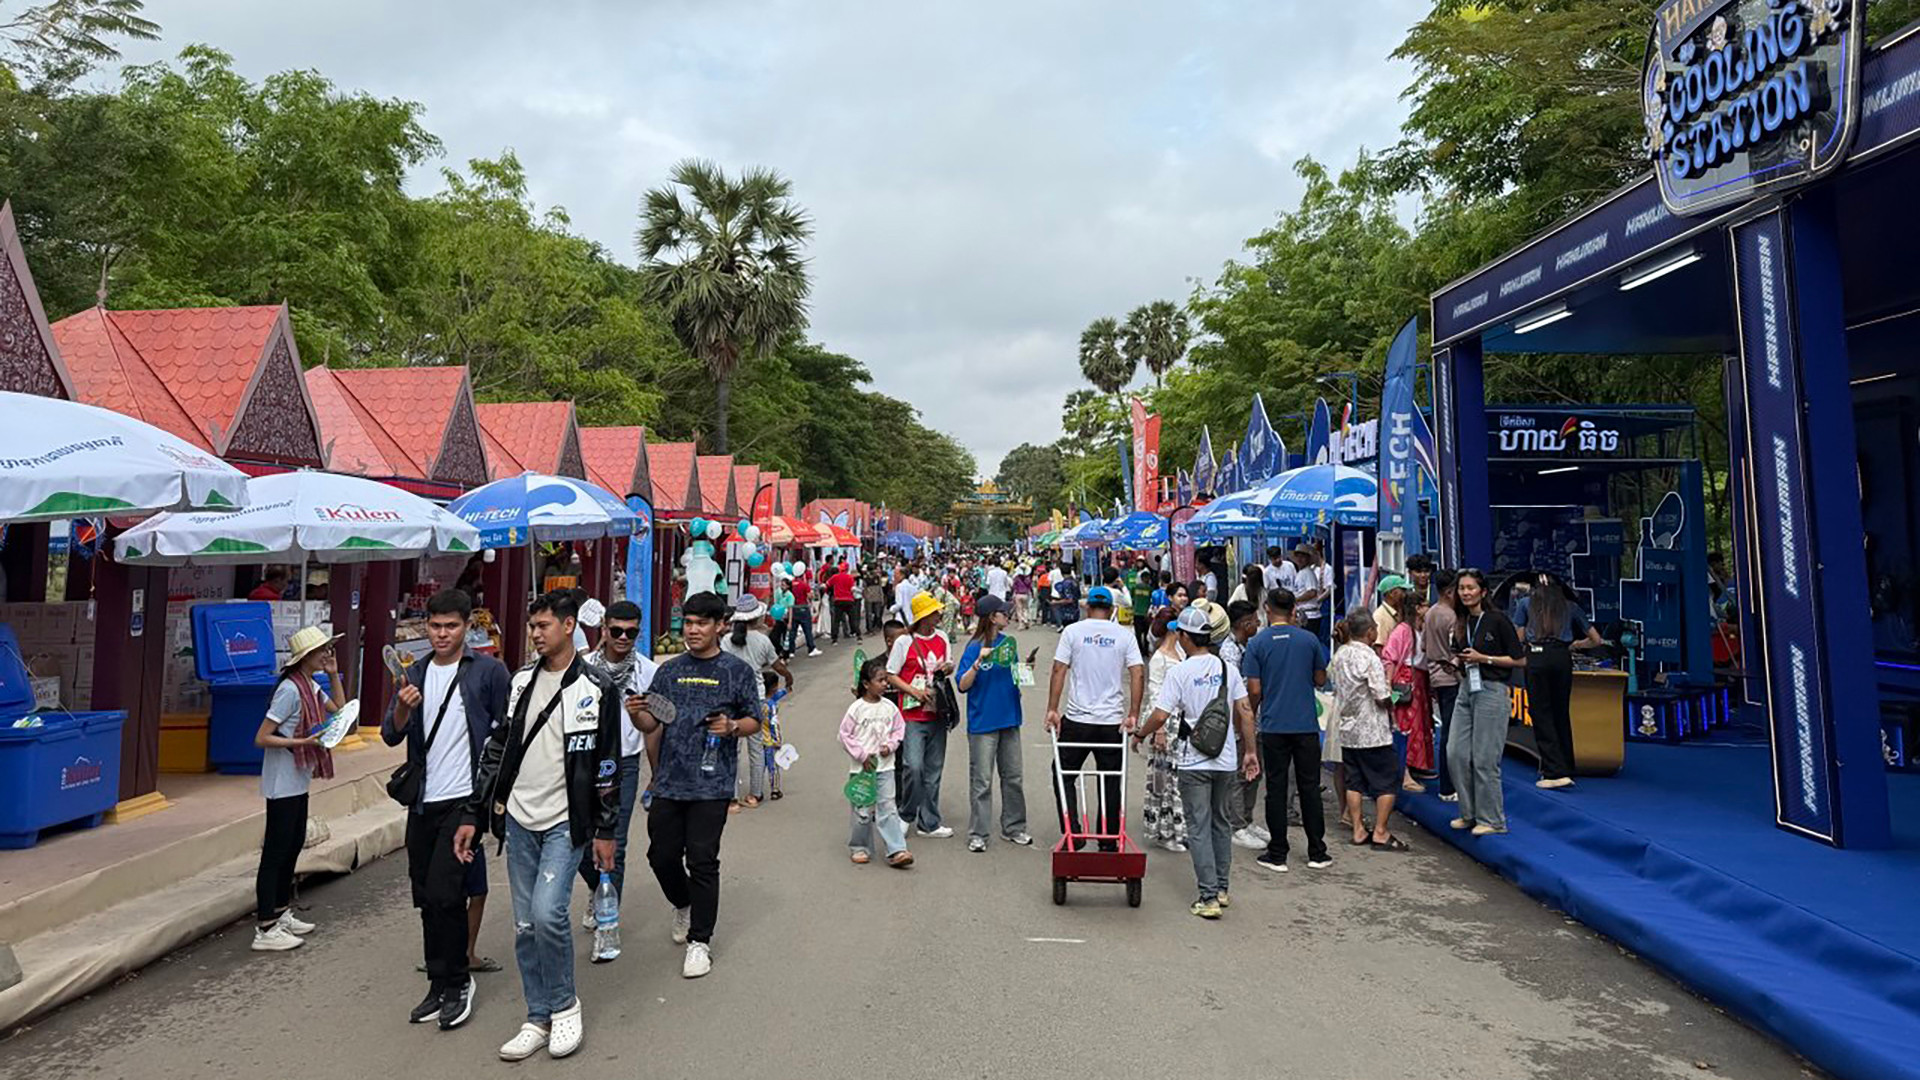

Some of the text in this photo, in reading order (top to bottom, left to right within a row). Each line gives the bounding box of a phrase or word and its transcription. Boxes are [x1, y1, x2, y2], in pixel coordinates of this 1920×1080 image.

[1669, 1, 1803, 123] COOLING
[1671, 60, 1811, 179] STATION
[1555, 231, 1609, 271] HANUMAN
[1499, 265, 1543, 298] HANUMAN
[1758, 234, 1782, 390] HANUMAN
[1499, 420, 1619, 451] ហាយ ធិច
[325, 503, 402, 520] Kulen
[463, 508, 521, 522] HI-TECH
[1773, 435, 1800, 598] HANUMAN
[1083, 634, 1116, 645] HI-TECH
[1790, 643, 1818, 815] HANUMAN
